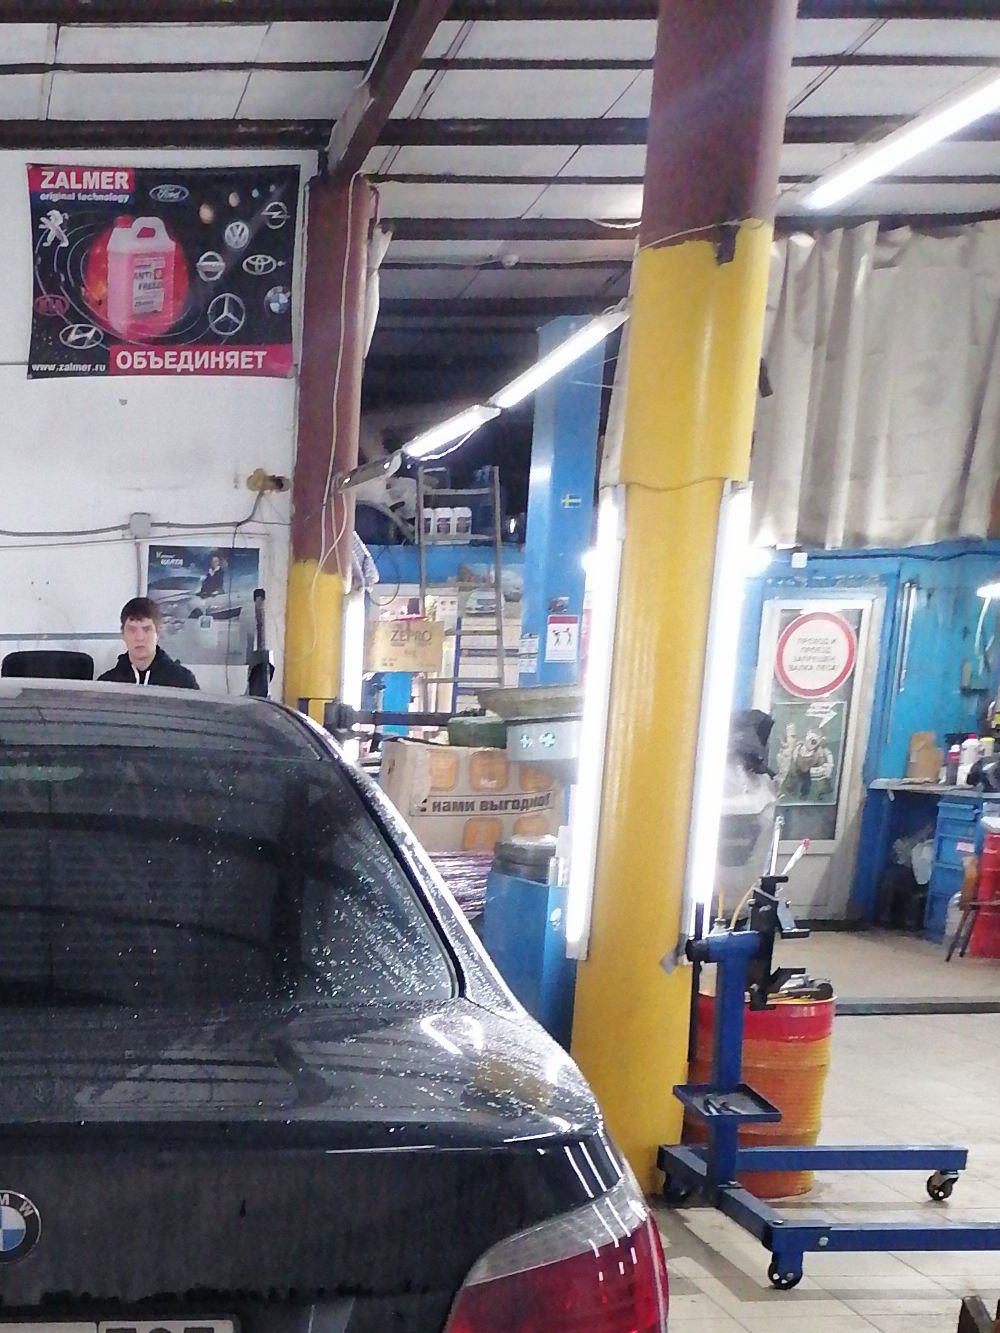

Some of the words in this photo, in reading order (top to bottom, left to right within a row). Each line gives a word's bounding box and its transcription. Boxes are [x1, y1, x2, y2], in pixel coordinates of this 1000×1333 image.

[40, 171, 129, 190] ZALMER
[40, 192, 75, 202] original
[77, 193, 130, 203] technology
[32, 362, 106, 372] www.zalmer.ru
[116, 350, 267, 373] ОБЪЕДИНЯЕТ
